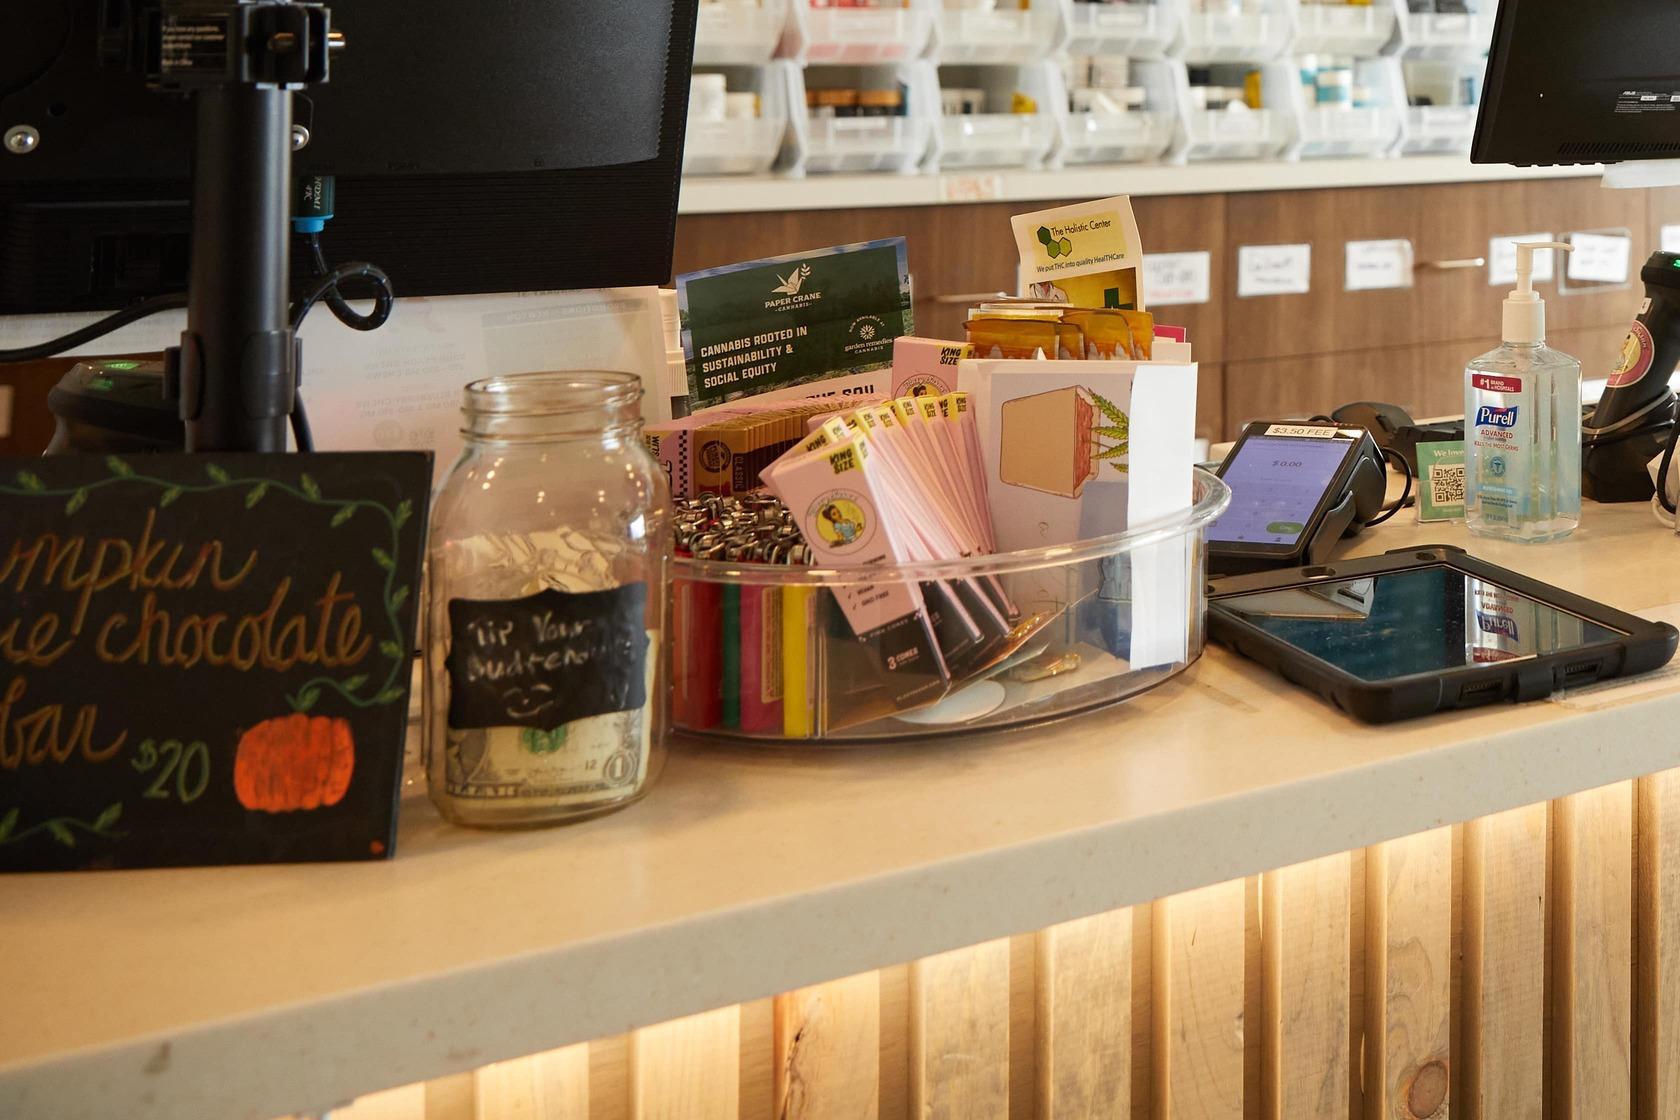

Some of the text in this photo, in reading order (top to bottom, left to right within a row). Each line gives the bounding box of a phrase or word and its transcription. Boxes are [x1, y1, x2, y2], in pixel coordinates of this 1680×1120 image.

[1051, 219, 1112, 237] The Holistic Center
[1054, 262, 1065, 270] THC
[1065, 261, 1076, 269] into
[765, 291, 822, 309] PAPER CRANE
[777, 303, 809, 312] CANNABIS
[700, 325, 808, 359] CANNABIS ROOTED IN
[844, 338, 893, 352] garden remedies
[702, 344, 794, 374] SUSTAINABILITY &
[941, 347, 961, 357] KING
[940, 356, 959, 366] SIZE
[704, 362, 778, 389] SOCIAL EQUITY
[1480, 378, 1490, 389] #1
[1480, 407, 1514, 426] Purell
[1272, 427, 1331, 437] $3.50 FEE
[1481, 429, 1514, 439] ADVANCED
[829, 448, 853, 465] KING
[734, 455, 744, 489] CLASSIC
[834, 459, 855, 474] SIZE
[0, 507, 259, 636] mpkin
[96, 573, 372, 672] chocolate
[887, 655, 897, 670] 3
[0, 675, 128, 769] bar
[131, 737, 211, 805] $20
